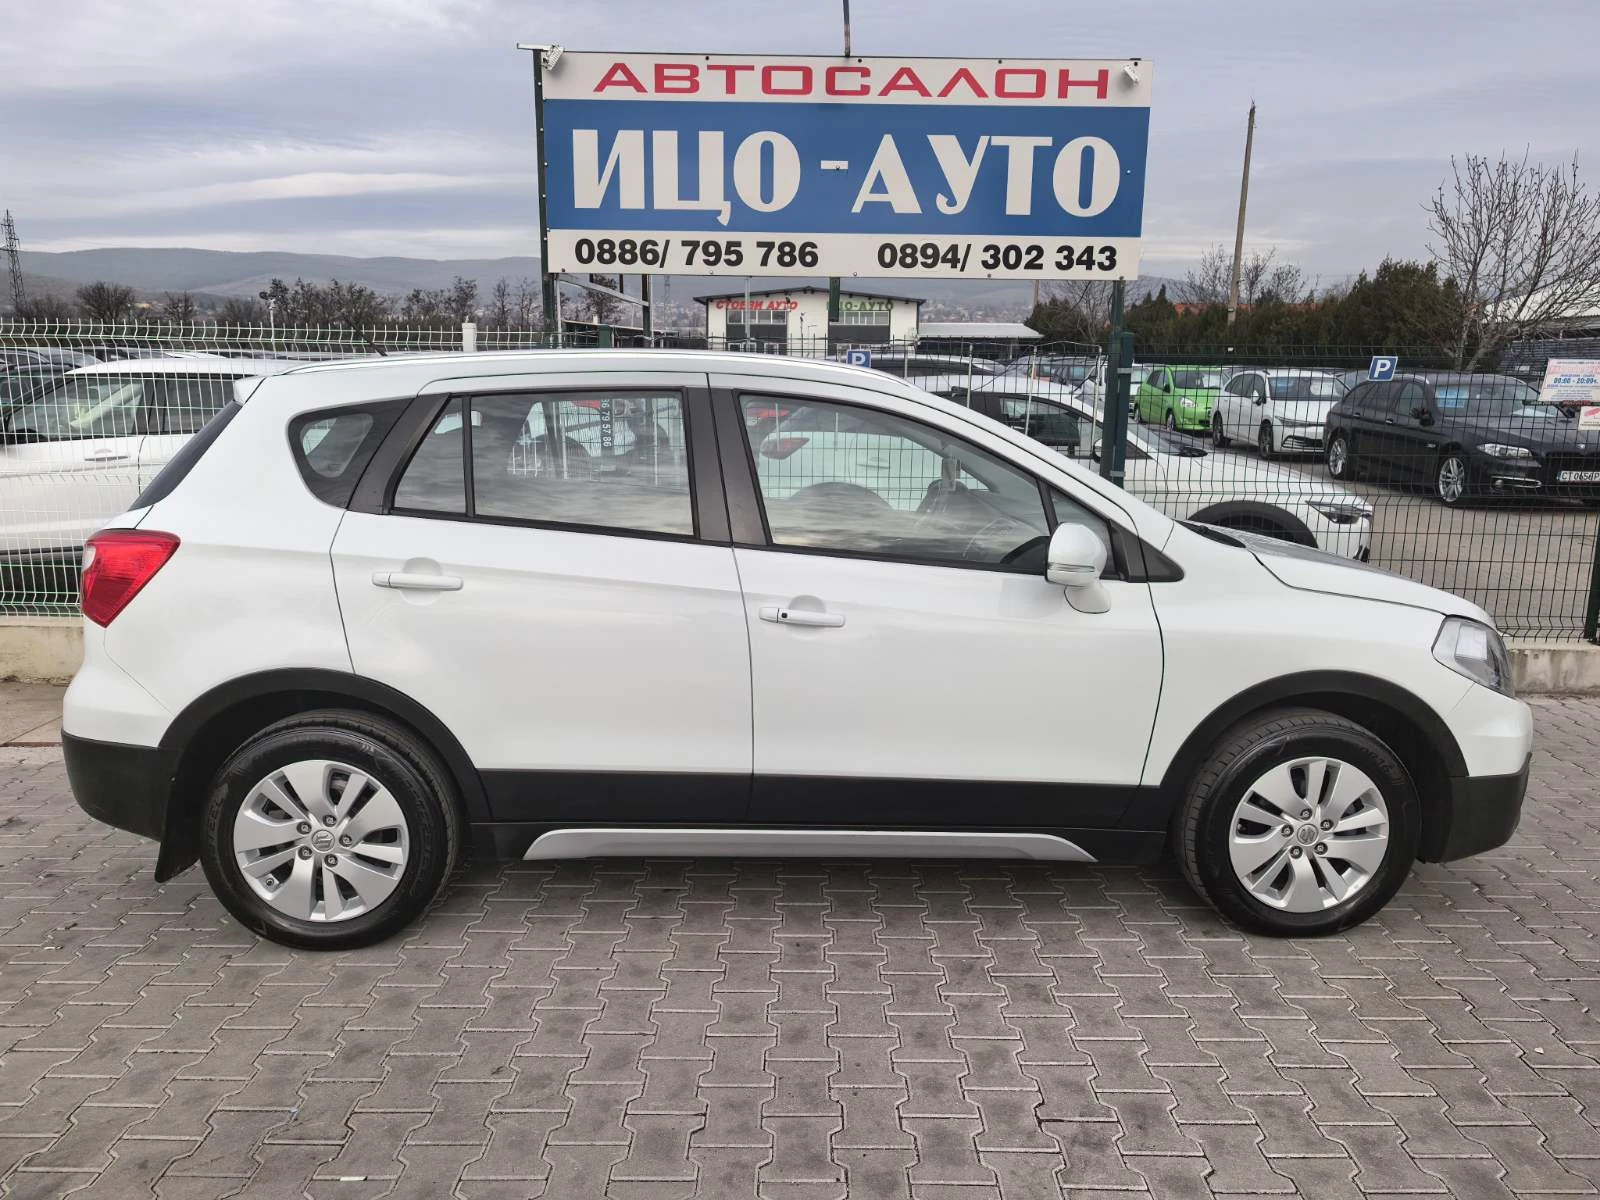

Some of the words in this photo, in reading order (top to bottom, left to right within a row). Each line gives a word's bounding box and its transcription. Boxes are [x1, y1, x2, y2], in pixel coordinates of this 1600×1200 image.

[593, 63, 1109, 99] АВТОСАЛОН
[575, 239, 670, 268] 0886/
[681, 240, 743, 267] 795
[756, 241, 819, 268] 786
[877, 242, 971, 272] 0894/
[981, 244, 1044, 270] 302
[1055, 245, 1117, 271] 343
[851, 352, 865, 364] P
[1373, 360, 1391, 378] P
